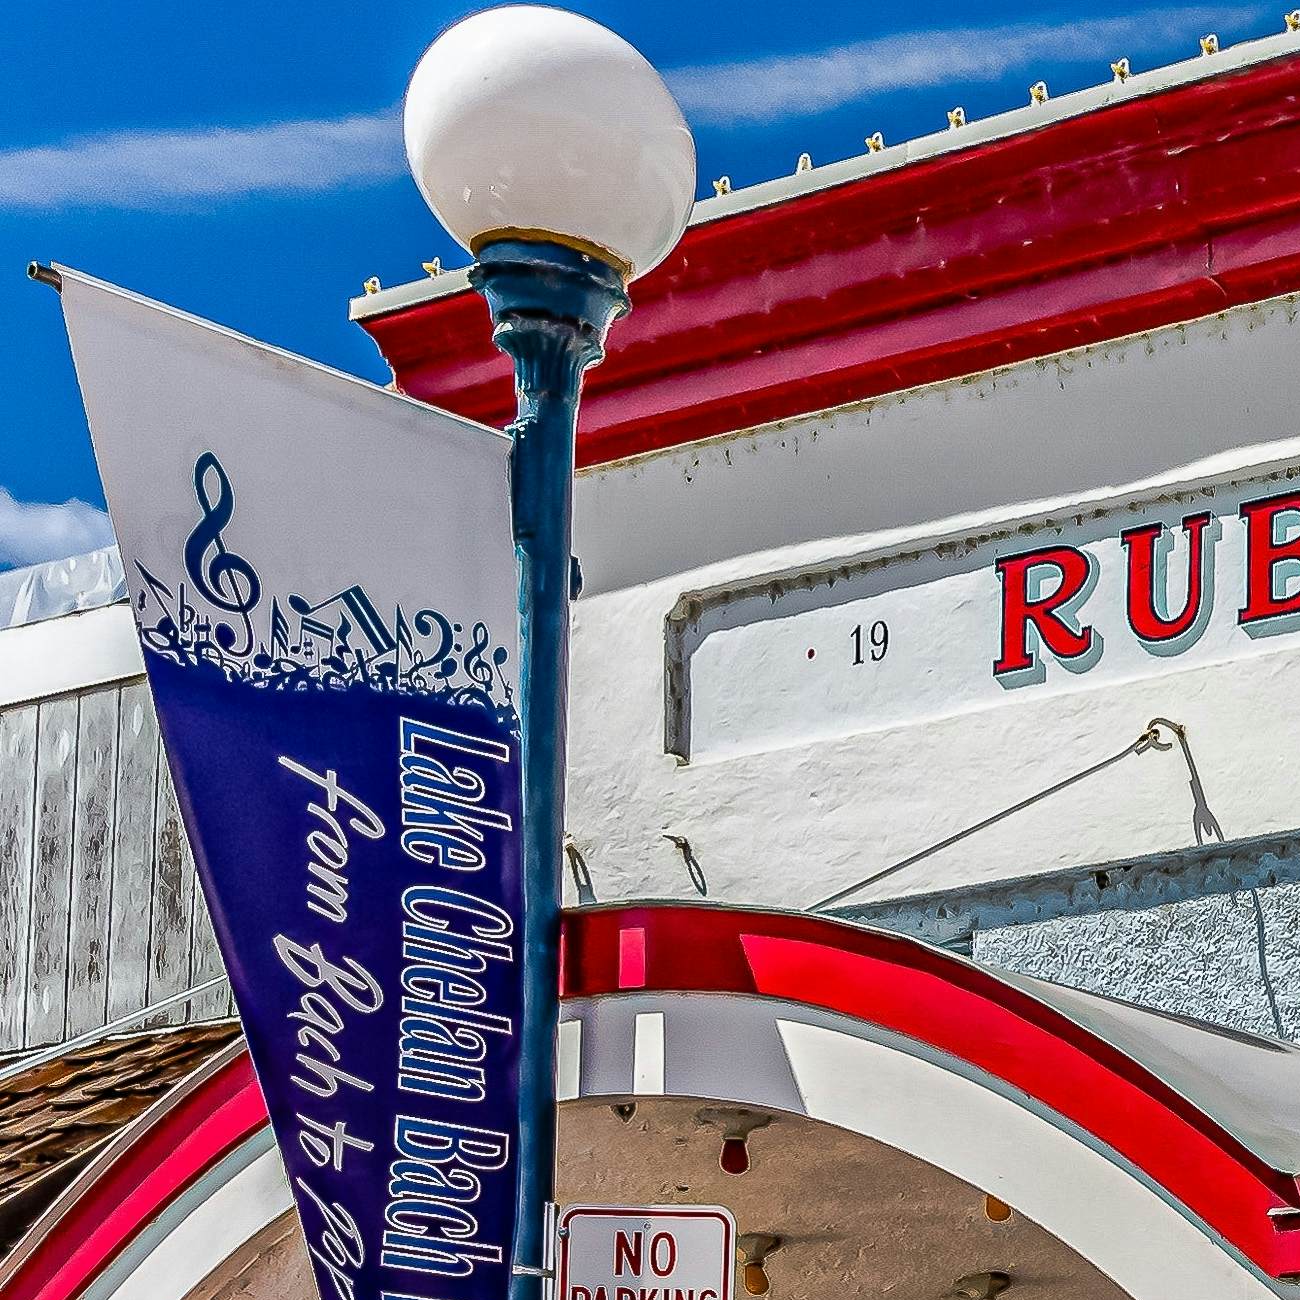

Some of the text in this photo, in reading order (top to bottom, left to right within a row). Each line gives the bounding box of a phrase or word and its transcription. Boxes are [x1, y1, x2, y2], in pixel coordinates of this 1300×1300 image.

[850, 620, 888, 666] 19
[400, 716, 513, 871] Lake
[273, 933, 384, 1097] Bach
[398, 886, 513, 1101] Chelan
[296, 1112, 375, 1171] to
[380, 1114, 510, 1277] Bach
[614, 1231, 677, 1277] NO
